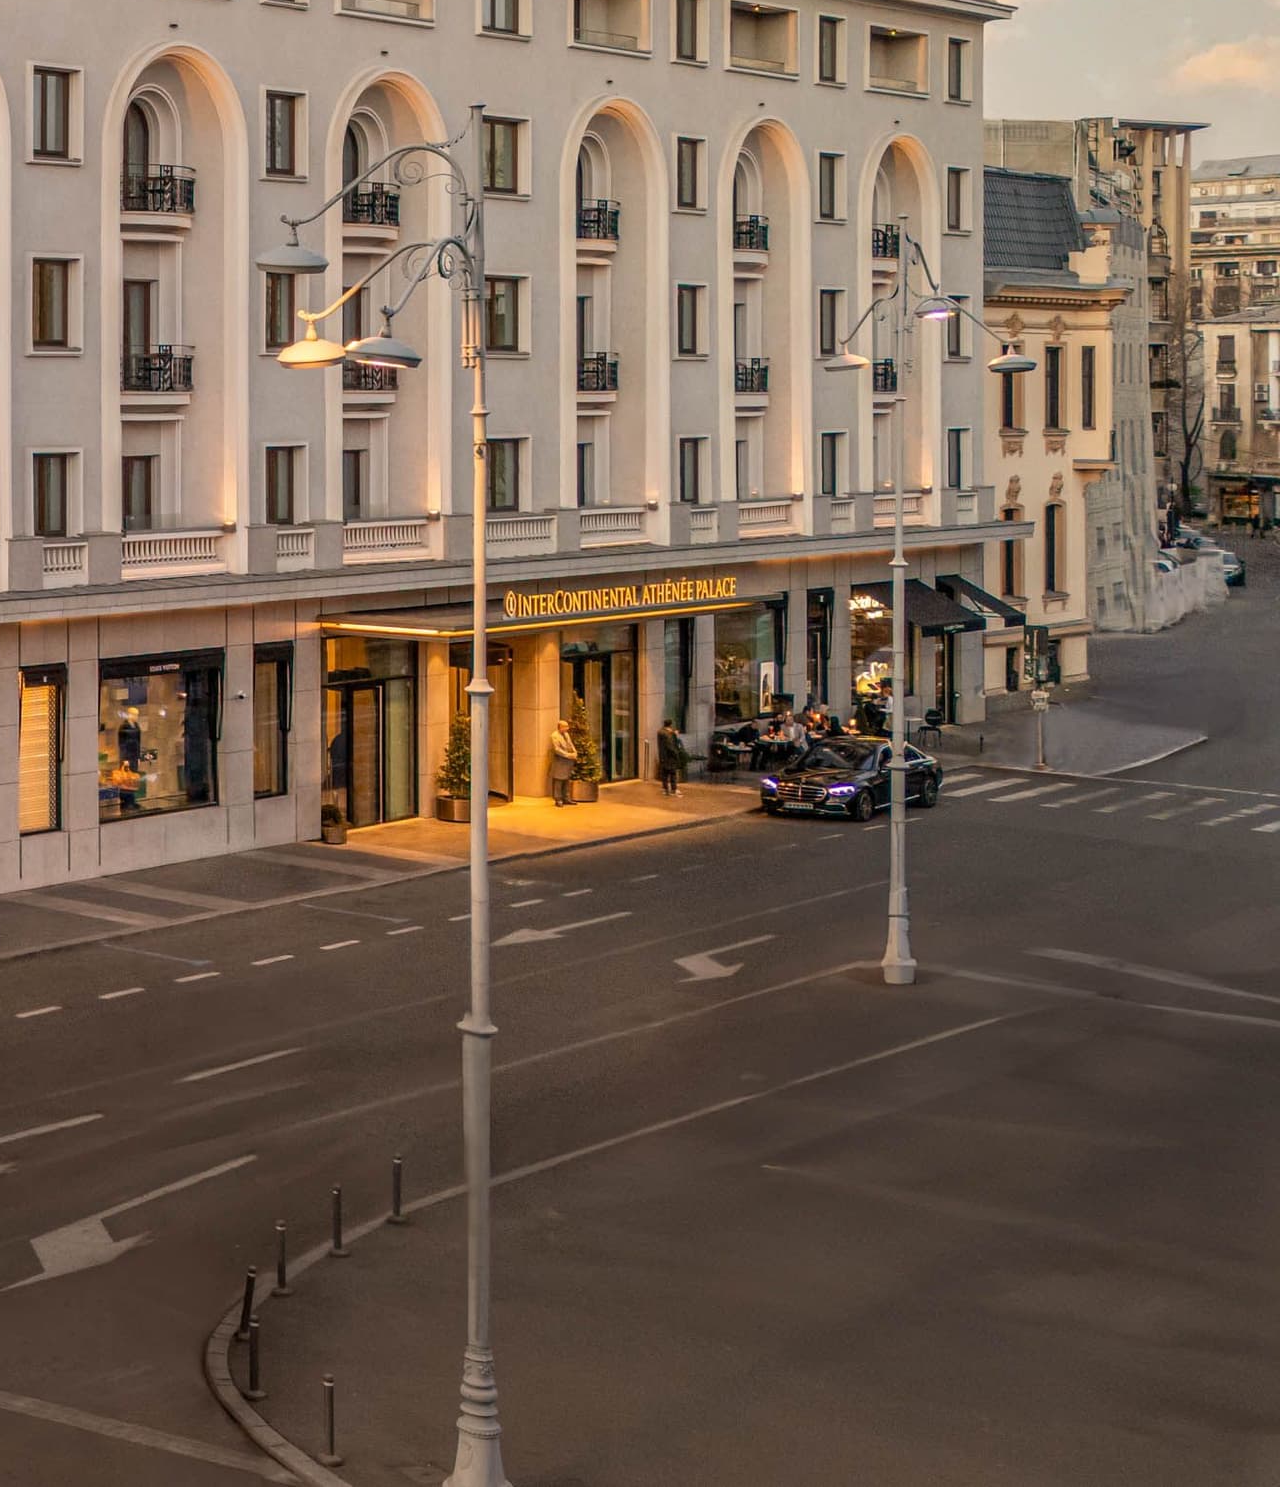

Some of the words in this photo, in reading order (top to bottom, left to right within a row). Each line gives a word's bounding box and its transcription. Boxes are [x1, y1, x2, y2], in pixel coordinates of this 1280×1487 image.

[517, 585, 639, 617] INTERCONTINENTAL
[642, 578, 694, 605] ATHÉNÉE
[696, 577, 737, 599] PALACE
